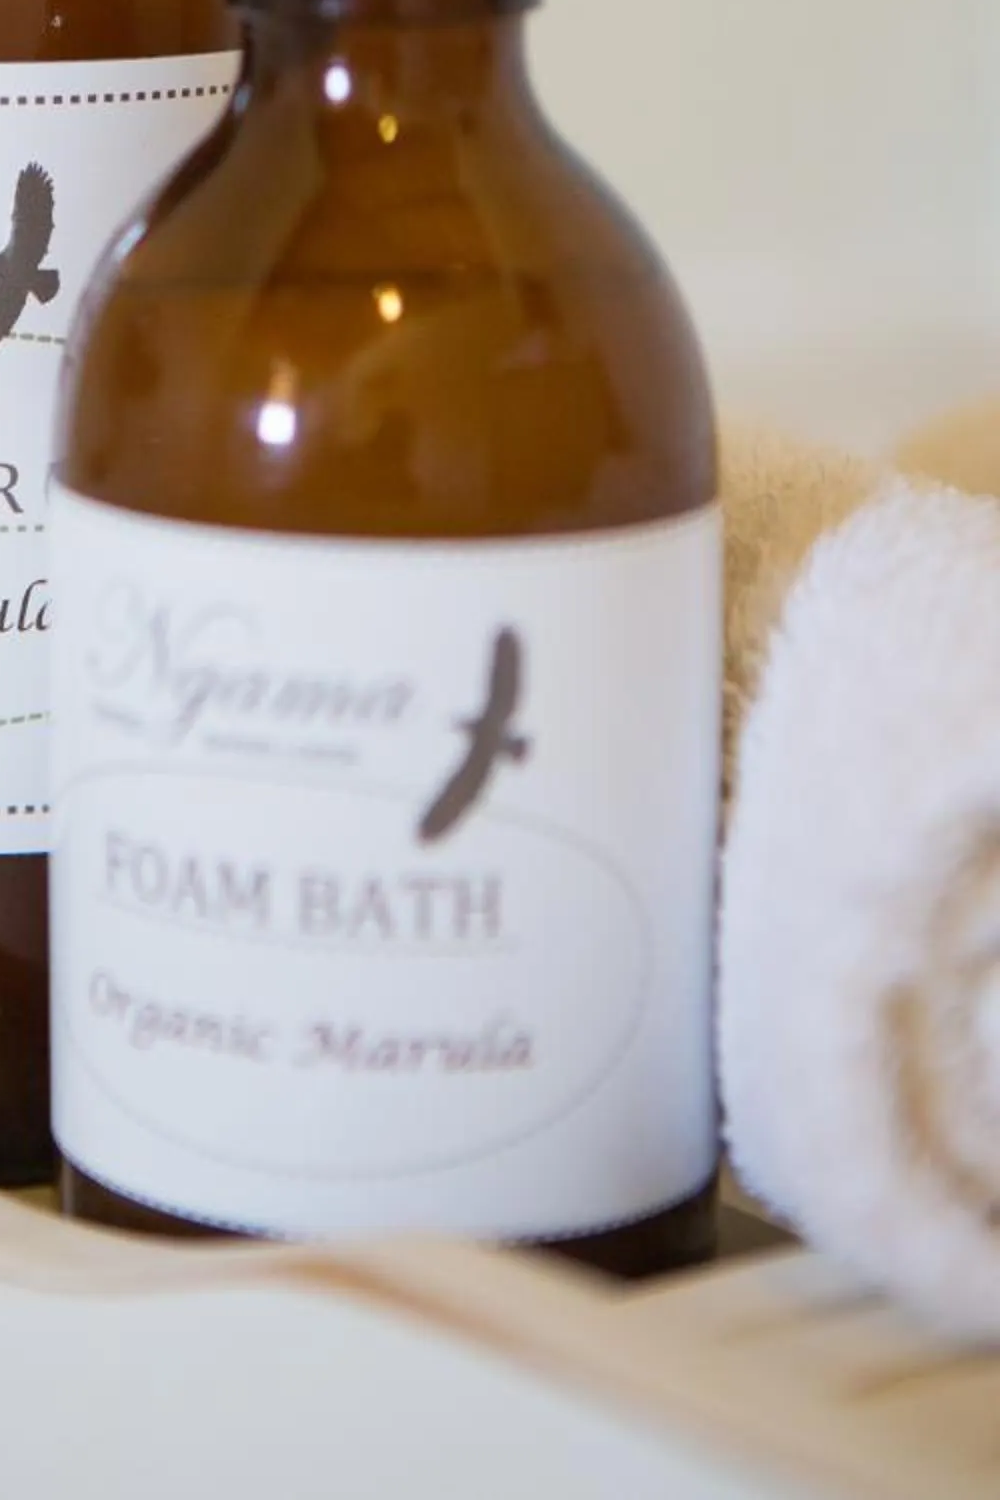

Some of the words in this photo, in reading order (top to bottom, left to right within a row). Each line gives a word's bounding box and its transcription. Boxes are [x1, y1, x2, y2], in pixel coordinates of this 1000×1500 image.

[104, 829, 272, 928] FOAM
[296, 873, 503, 941] BATH
[88, 966, 272, 1066] Organic
[292, 1008, 535, 1074] Marula
